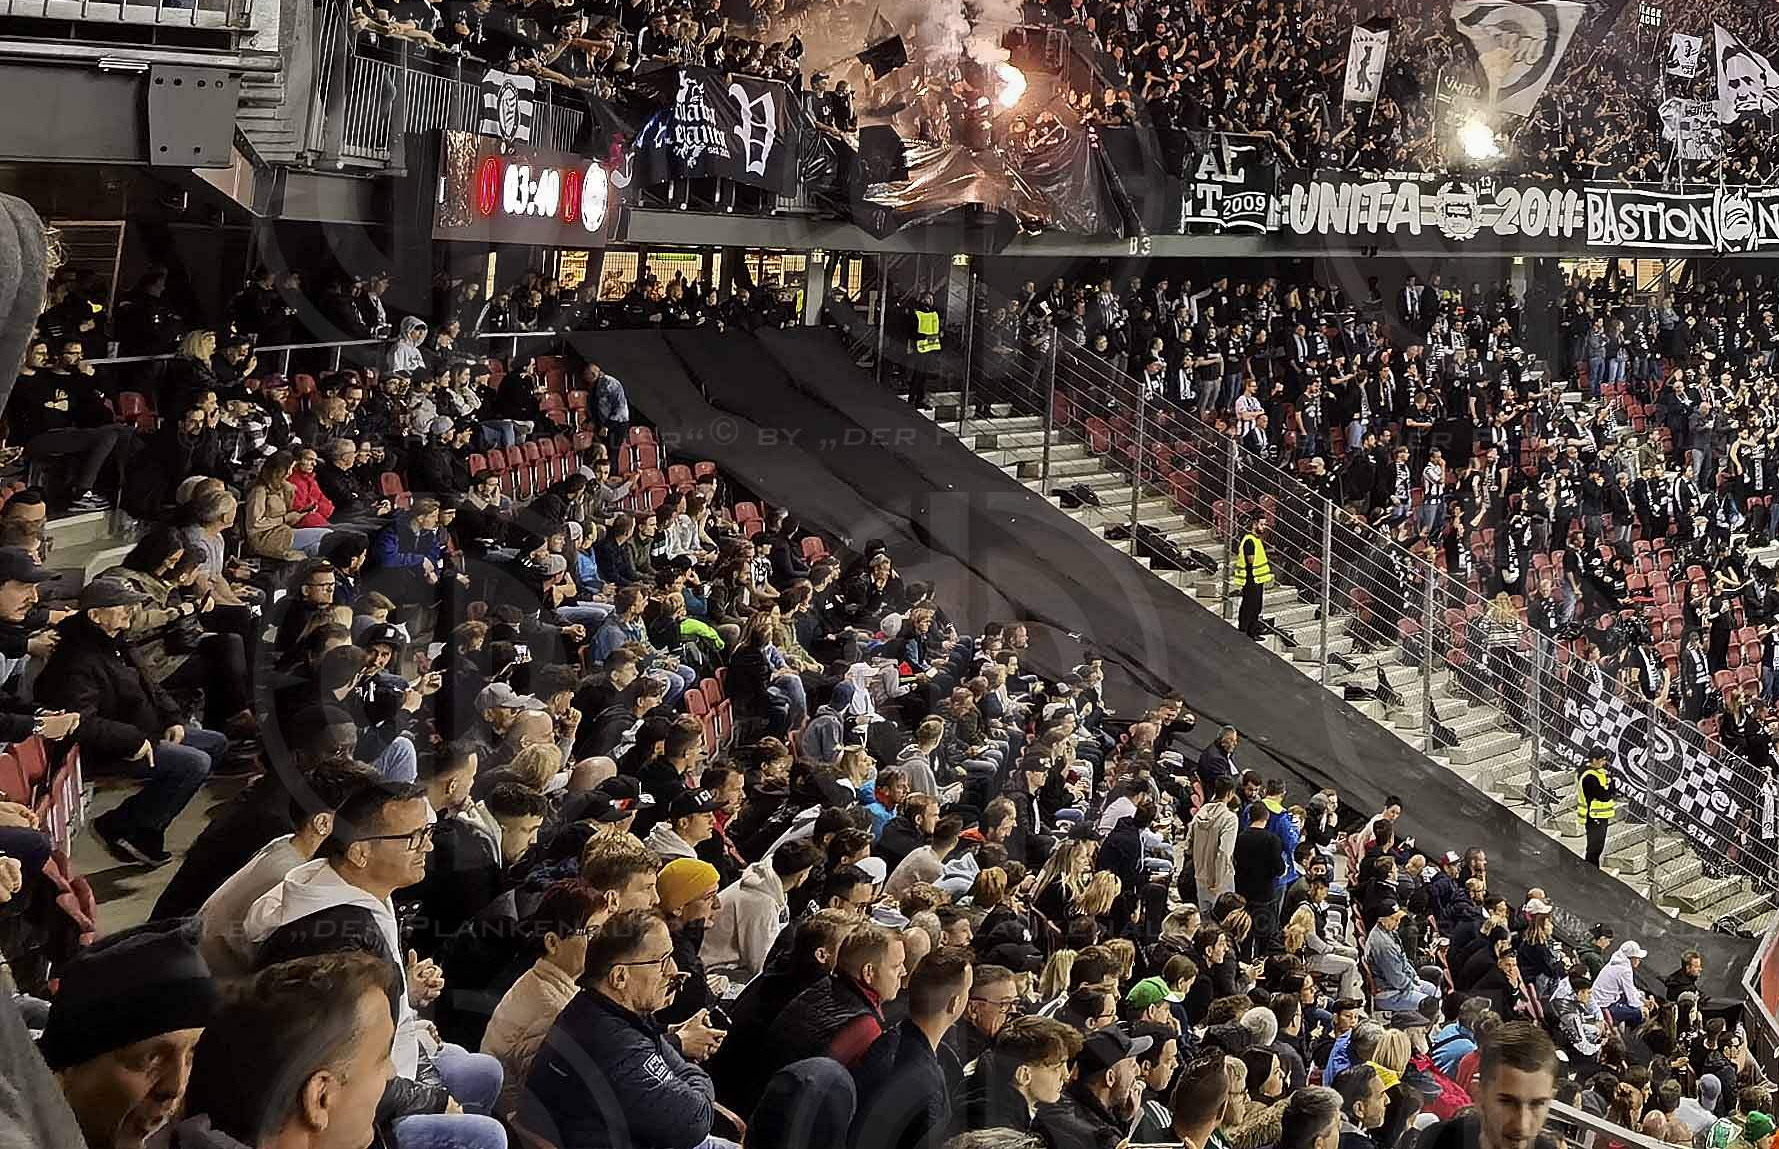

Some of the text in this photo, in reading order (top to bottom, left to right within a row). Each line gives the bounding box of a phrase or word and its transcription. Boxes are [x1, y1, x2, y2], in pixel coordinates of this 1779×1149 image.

[1223, 195, 1266, 217] 2009
[1290, 181, 1578, 237] UNITA 2011
[1586, 192, 1715, 246] BASTION
